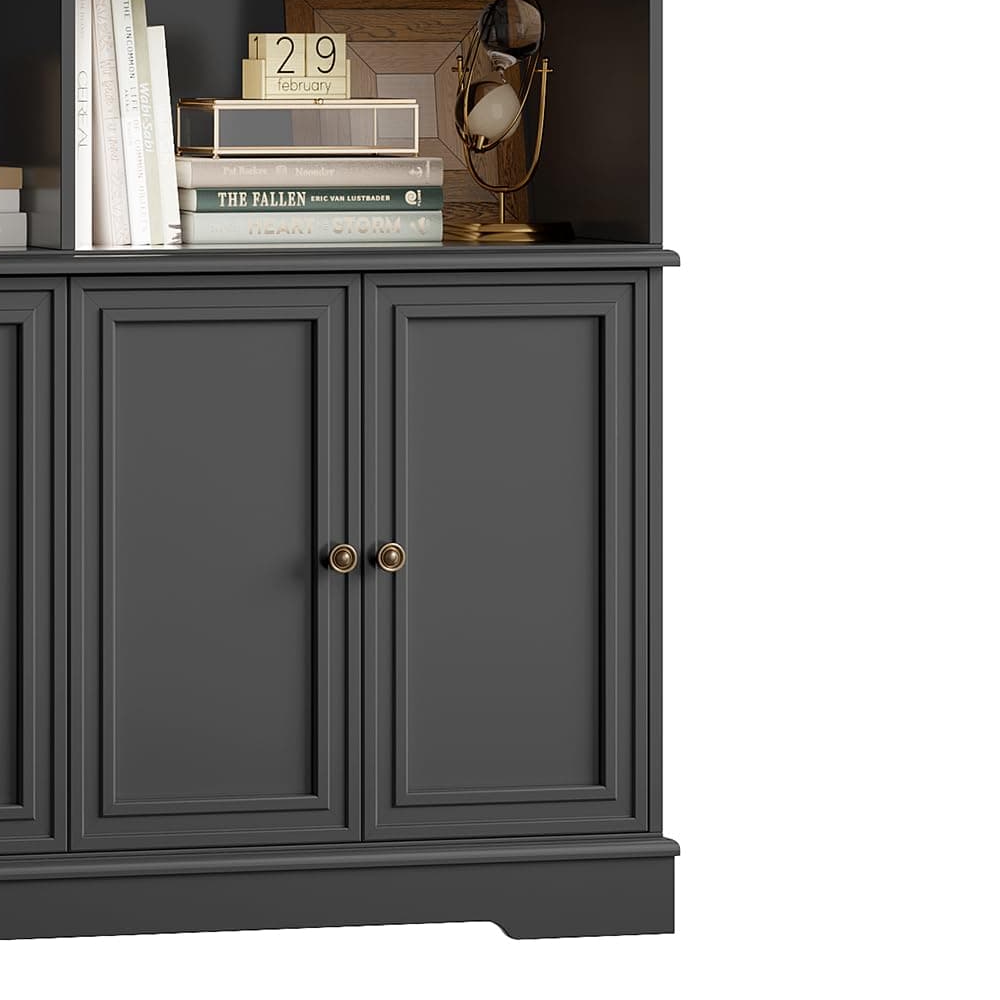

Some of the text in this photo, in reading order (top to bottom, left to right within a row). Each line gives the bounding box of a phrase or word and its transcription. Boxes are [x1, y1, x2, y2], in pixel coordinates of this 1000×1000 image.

[125, 26, 136, 79] UNCOMMON
[253, 36, 336, 74] 1 2 9
[277, 77, 331, 94] february
[139, 83, 155, 152] Wabi-Sabi
[217, 191, 247, 207] THE
[252, 191, 306, 207] FALLEN
[347, 194, 391, 202] LUSTBADER
[248, 218, 314, 235] HEART
[332, 216, 401, 233] STORM
